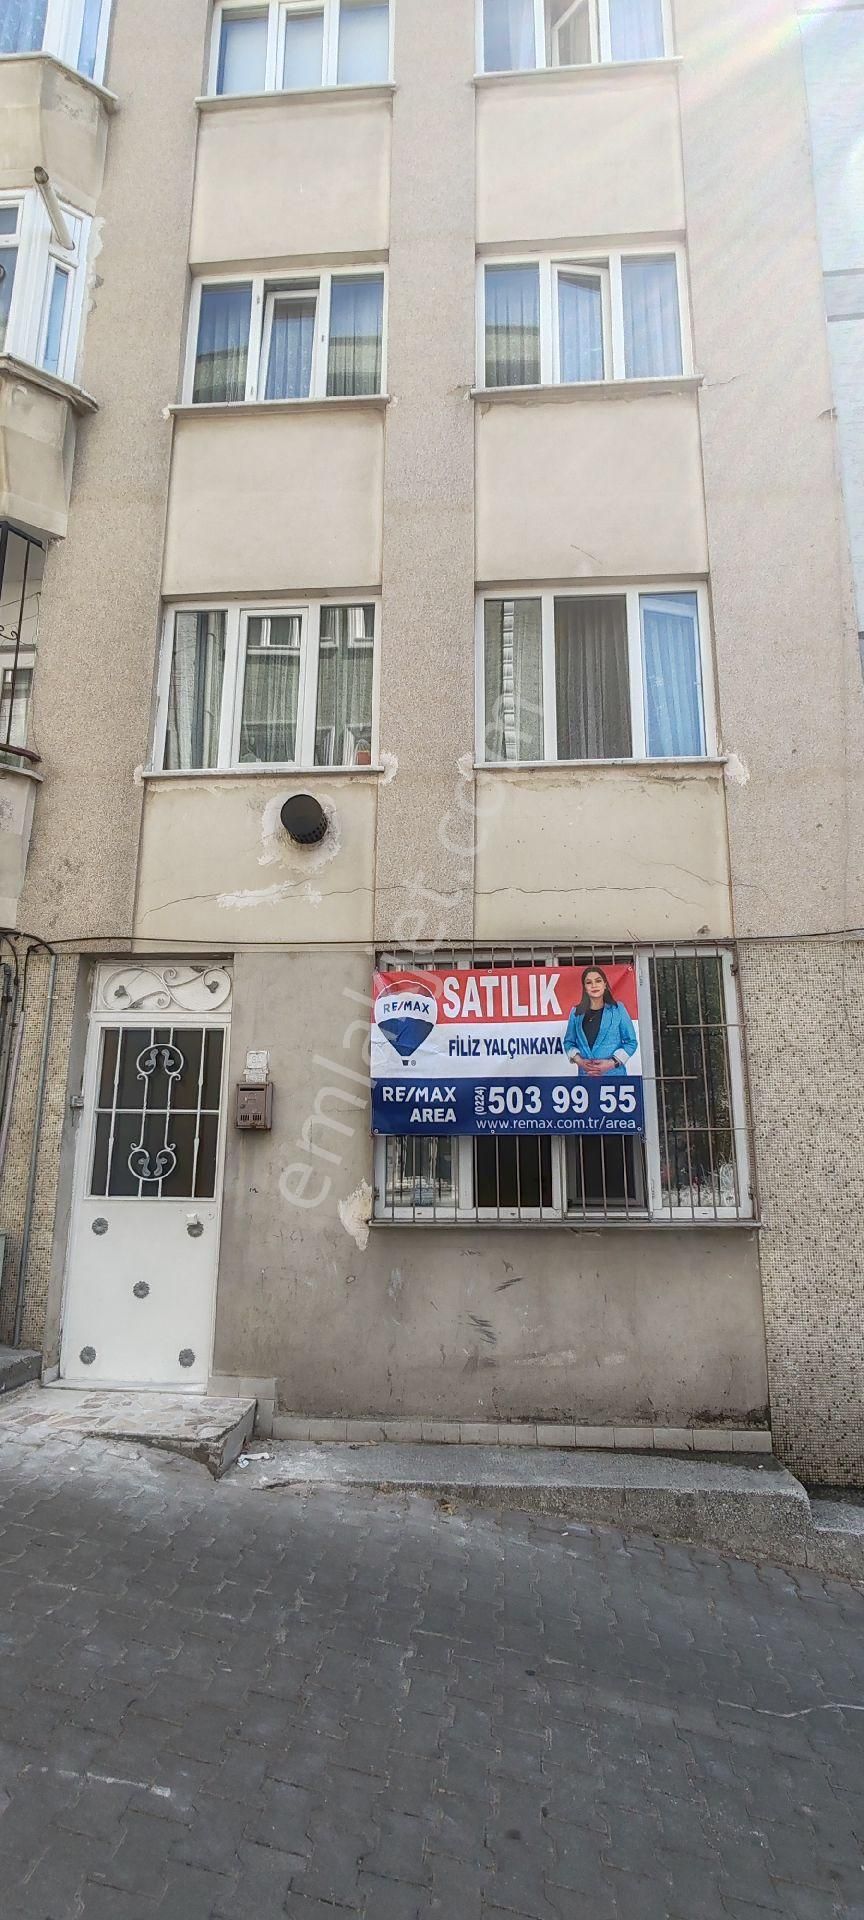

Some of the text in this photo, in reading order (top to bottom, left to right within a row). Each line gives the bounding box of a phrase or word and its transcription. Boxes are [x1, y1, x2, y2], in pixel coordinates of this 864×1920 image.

[442, 974, 563, 1018] SATILIK
[383, 1000, 430, 1015] RE/MAX
[448, 1035, 564, 1059] FİLİZ YALÇINKAYA
[382, 1086, 457, 1103] RE/MAX
[474, 1086, 487, 1115] (0224)
[487, 1085, 637, 1115] 503 99 55
[409, 1108, 457, 1123] AREA
[476, 1115, 636, 1130] www.remax.com.tr/area
